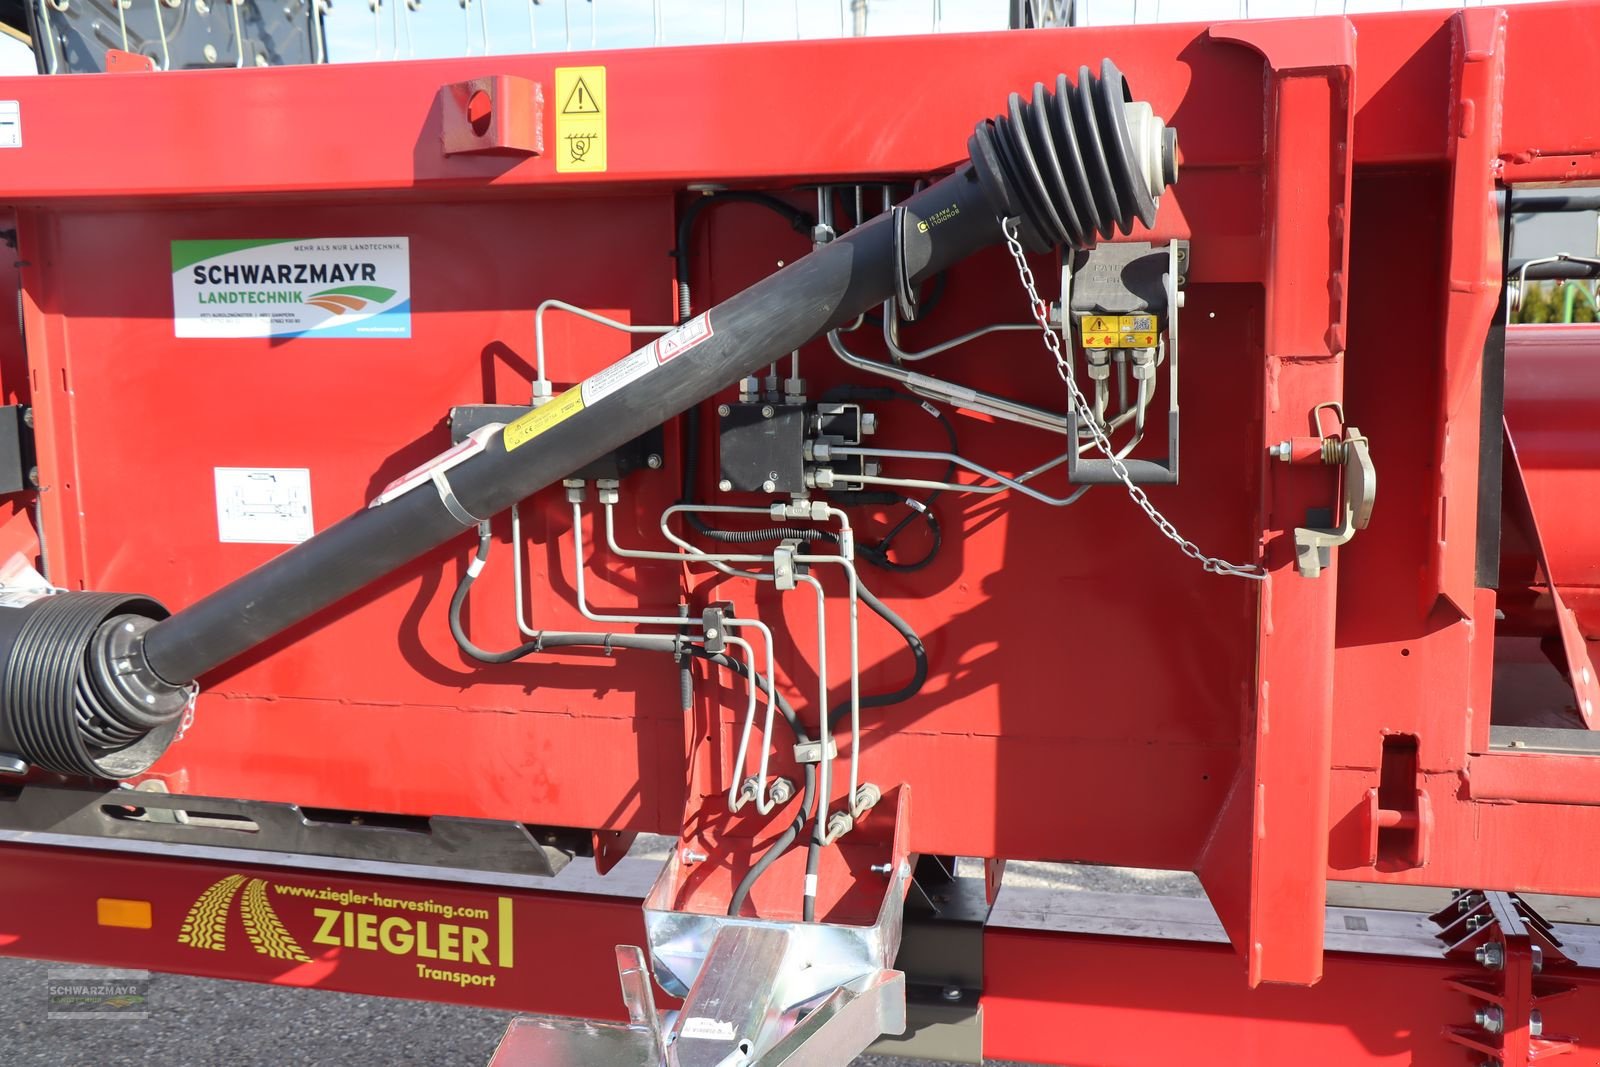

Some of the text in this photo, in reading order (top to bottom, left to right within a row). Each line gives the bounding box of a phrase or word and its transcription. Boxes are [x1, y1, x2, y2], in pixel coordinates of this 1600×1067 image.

[929, 207, 950, 222] PAVESI
[931, 208, 960, 227] BONDIOLI
[194, 263, 376, 284] SCHWARZMAYR
[198, 291, 303, 304] LANDTECHNIK
[274, 884, 489, 920] www.ziegler-harvesting.com
[312, 908, 491, 966] ZIEGLER
[416, 963, 496, 987] Transport
